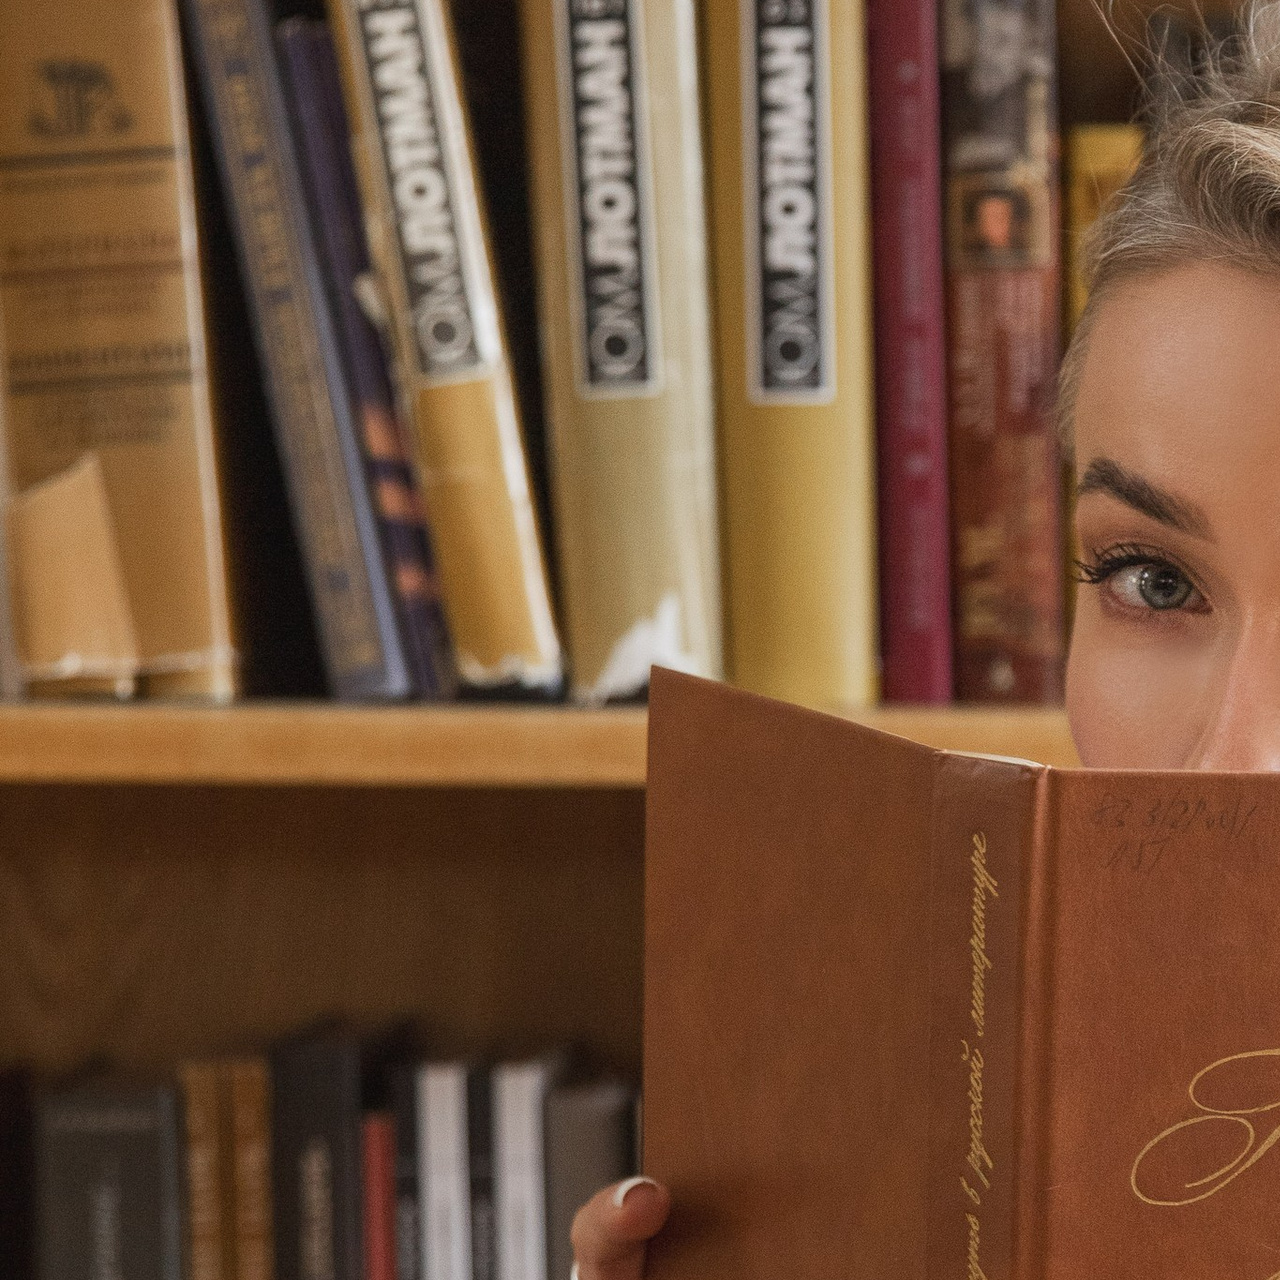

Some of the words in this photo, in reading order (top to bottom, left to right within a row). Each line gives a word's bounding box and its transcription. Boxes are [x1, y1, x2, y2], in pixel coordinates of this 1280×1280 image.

[969, 831, 999, 1038] литературе
[959, 1039, 994, 1189] русской
[959, 1176, 982, 1206] в
